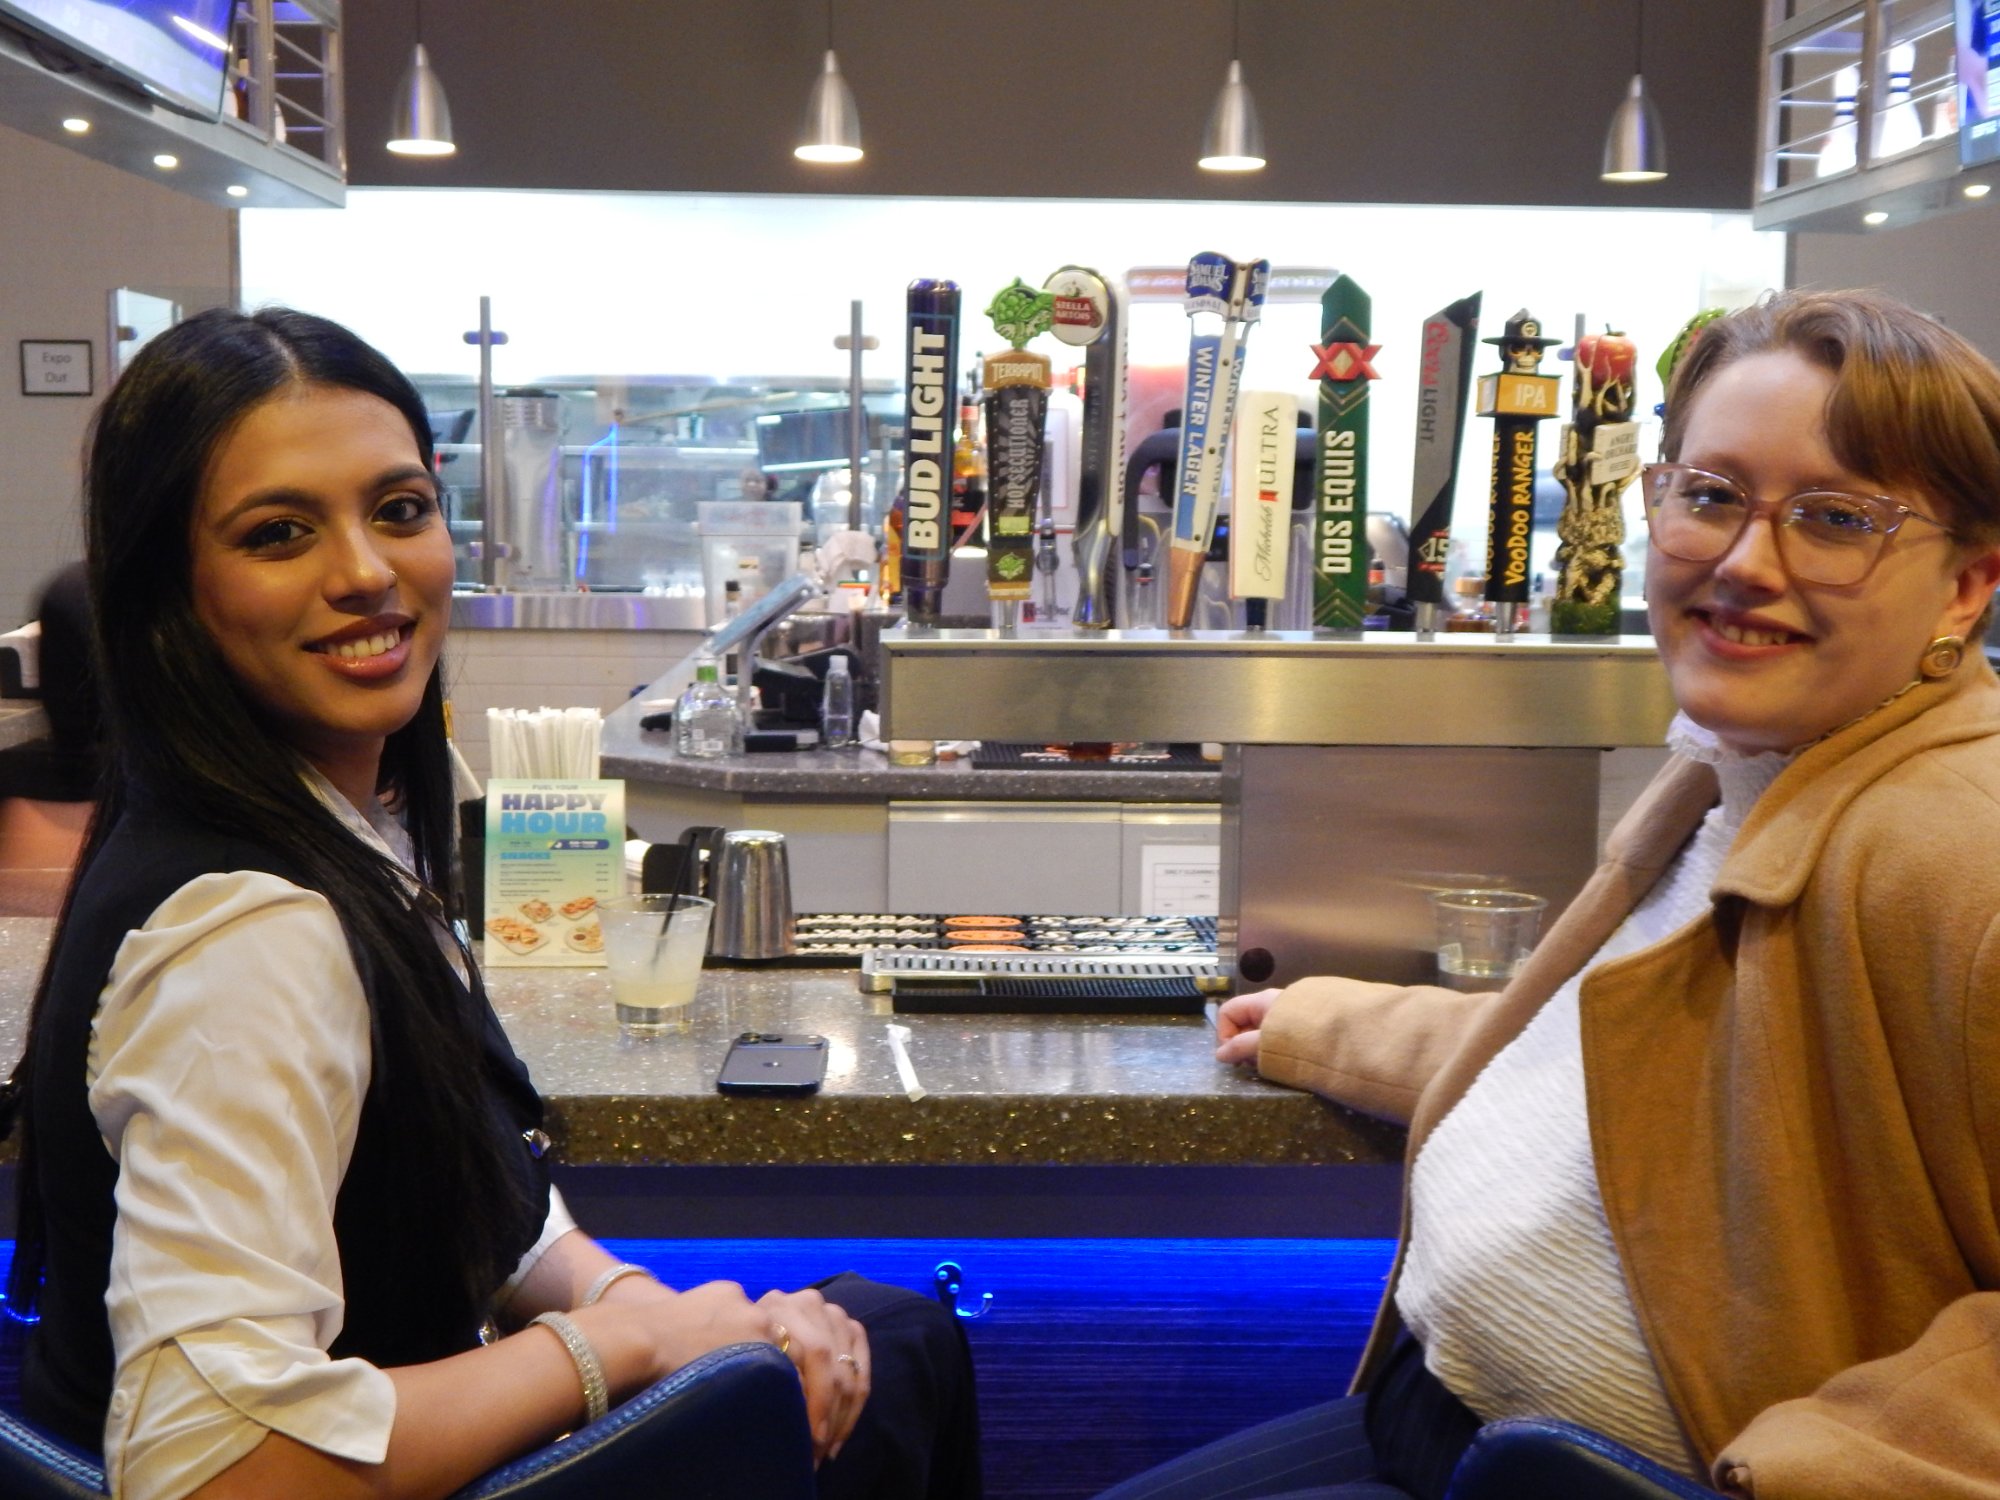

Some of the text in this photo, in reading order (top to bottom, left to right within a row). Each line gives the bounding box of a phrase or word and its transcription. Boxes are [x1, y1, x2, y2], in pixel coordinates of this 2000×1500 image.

[42, 352, 73, 365] Expo
[1183, 346, 1214, 496] WINTER LAGER
[1420, 388, 1438, 443] LIGHT
[1514, 382, 1547, 409] IPA
[908, 326, 946, 549] BUD LIGHT
[1260, 405, 1280, 486] ULTRA
[1321, 430, 1356, 574] DOS EQUIS
[1504, 430, 1535, 586] VOODOO RANGER
[501, 793, 608, 811] HAPPY
[501, 811, 607, 834] HOUR
